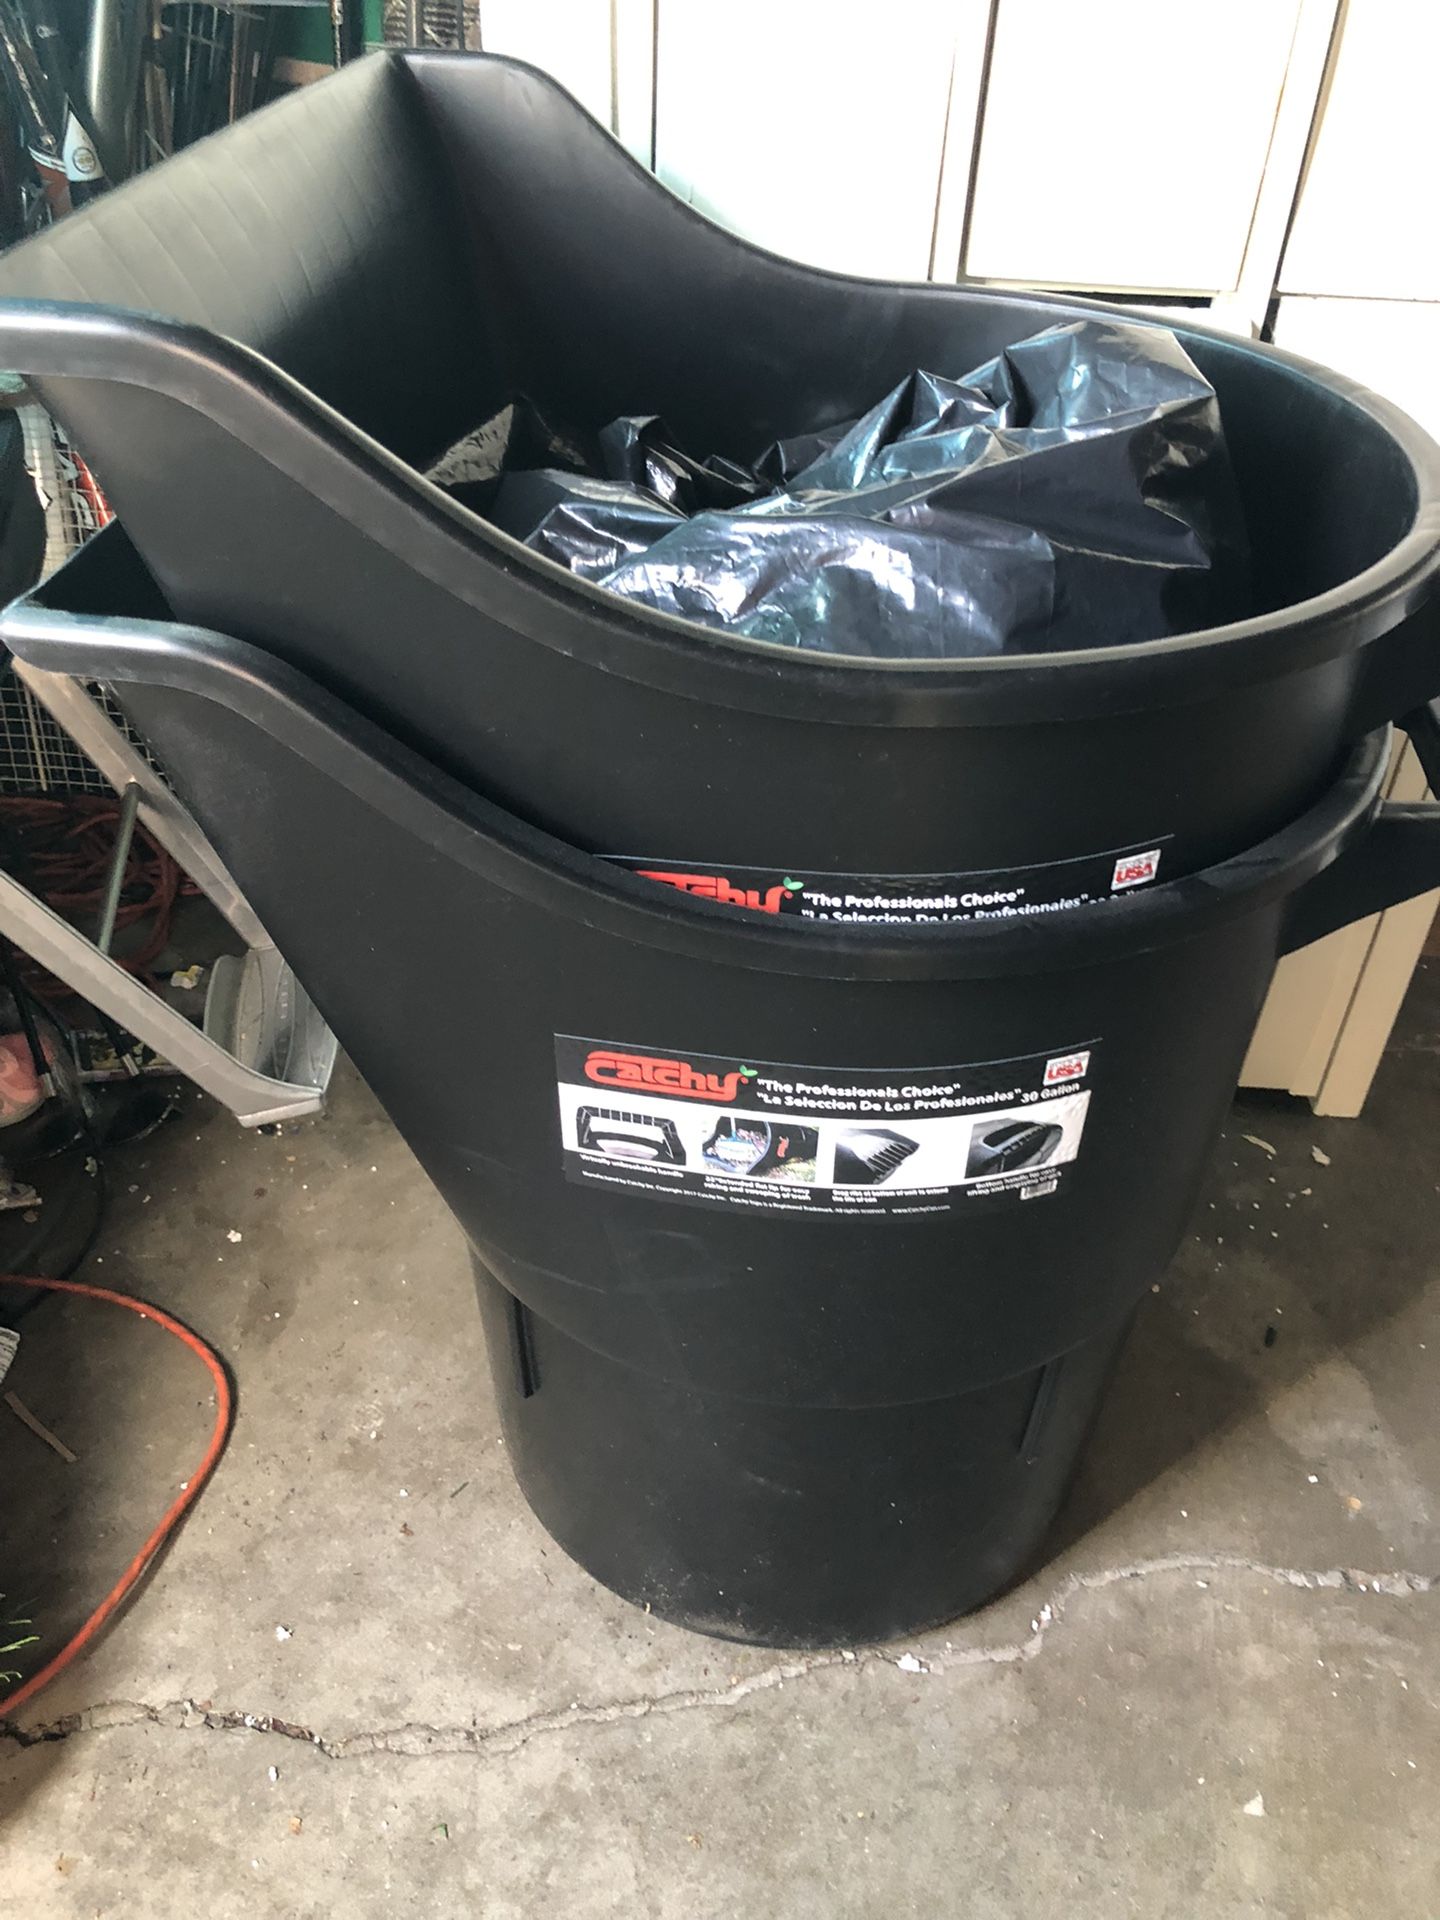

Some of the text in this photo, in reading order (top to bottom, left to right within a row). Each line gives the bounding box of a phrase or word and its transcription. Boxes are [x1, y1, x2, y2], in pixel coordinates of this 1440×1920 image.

[1115, 863, 1153, 884] USA
[634, 869, 786, 915] tchy
[802, 888, 1025, 910] "The Professionals Choice"
[757, 1078, 961, 1098] "The Professionals Choice"
[757, 1092, 782, 1105] "La
[784, 1096, 857, 1111] Seleccion
[859, 1101, 882, 1111] De
[885, 1102, 911, 1112] Los
[1021, 1092, 1039, 1104] 30
[1040, 1083, 1081, 1099] Gallon
[657, 1168, 684, 1178] handle
